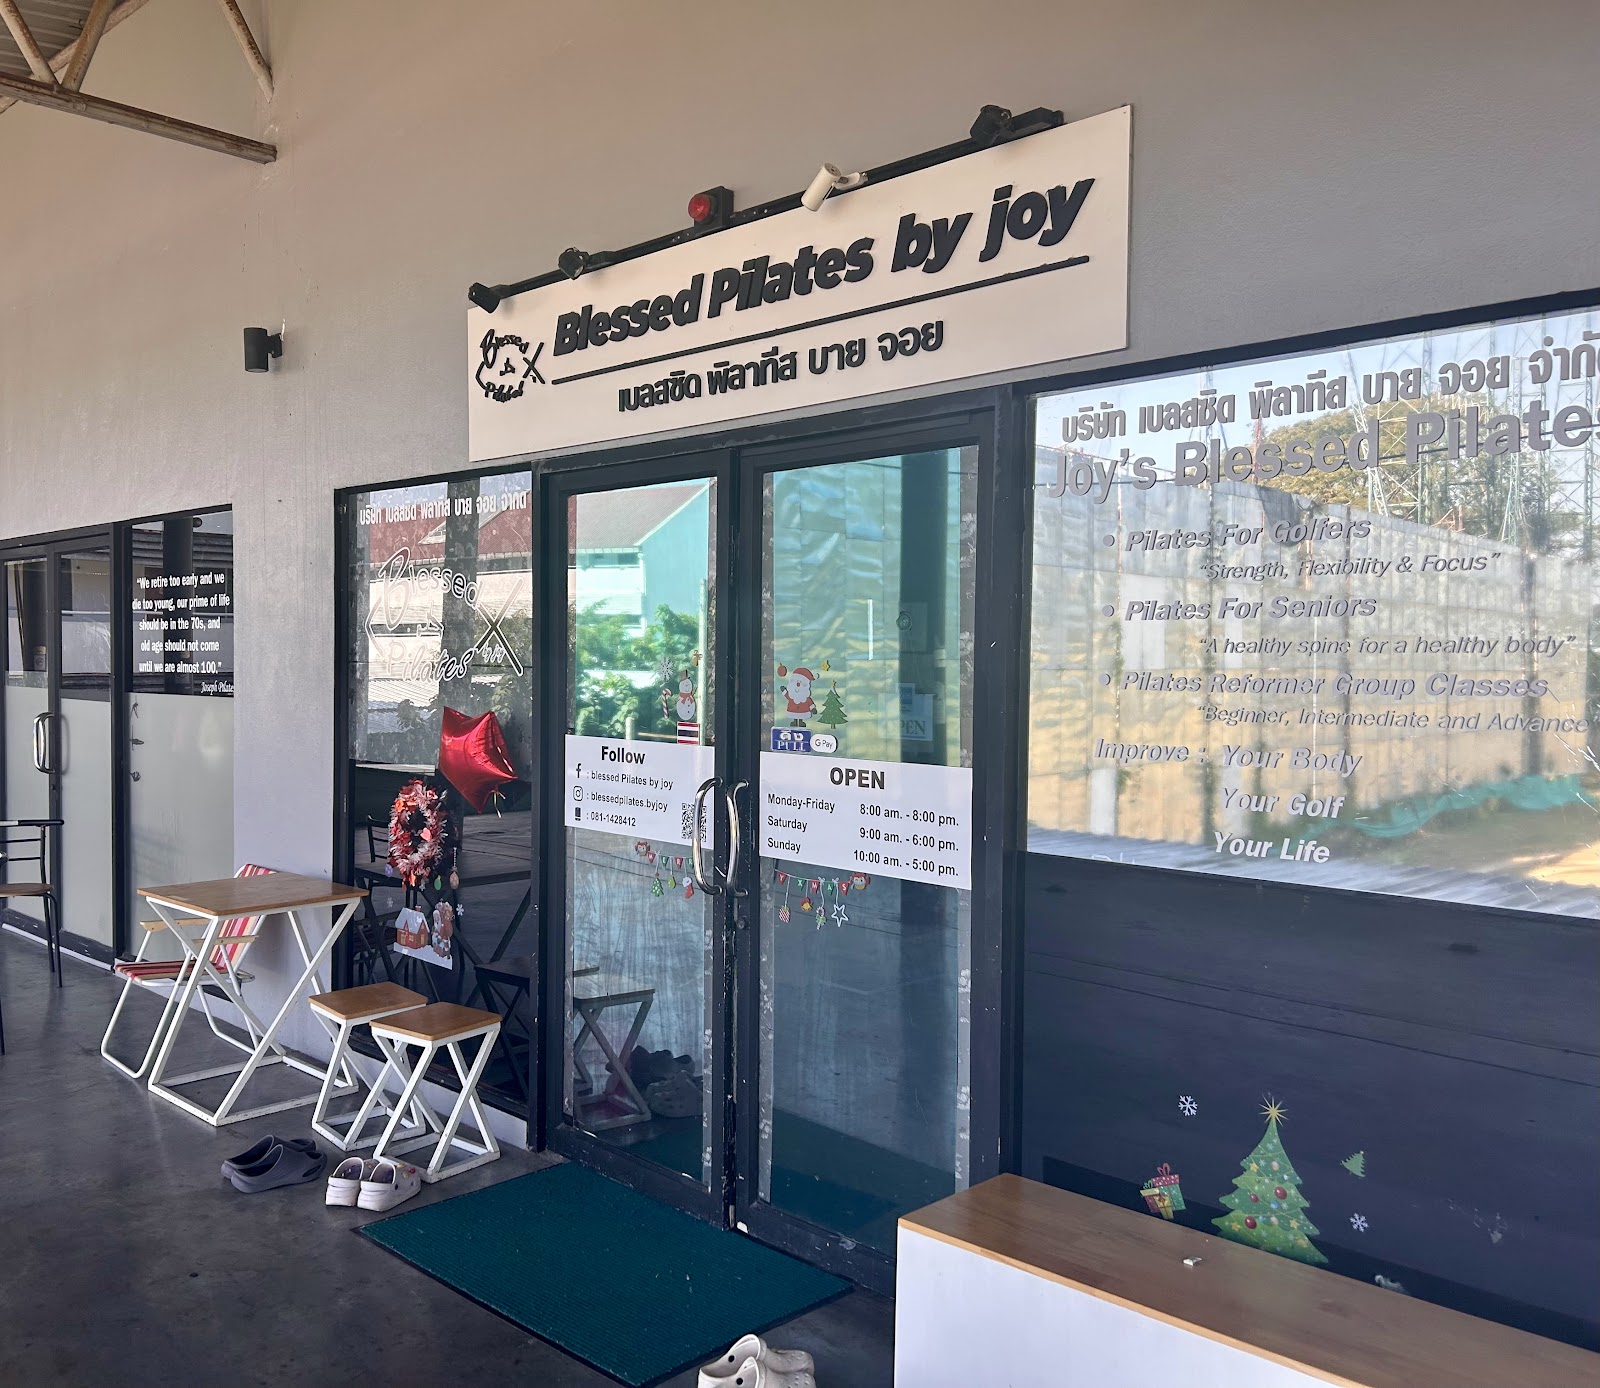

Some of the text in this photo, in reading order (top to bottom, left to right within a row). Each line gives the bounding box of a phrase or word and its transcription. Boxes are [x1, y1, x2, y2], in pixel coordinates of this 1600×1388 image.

[553, 177, 1095, 356] Blessed Pilates by joy
[808, 338, 866, 375] บาย
[877, 320, 944, 361] จอย
[1062, 401, 1126, 443] บริษัท
[1362, 367, 1422, 405] บาย
[1438, 355, 1511, 396] จอย
[1174, 419, 1380, 486] Blessed
[1406, 400, 1600, 465] Pilate
[1125, 517, 1372, 551] Pilates For Golfers
[150, 575, 168, 589] retire
[169, 575, 180, 587] too
[181, 573, 198, 588] early
[199, 572, 213, 585] and
[214, 573, 225, 584] we
[1298, 557, 1392, 578] Flexibility
[1395, 555, 1414, 573] &
[142, 598, 153, 610] too
[154, 597, 176, 612] young,
[176, 598, 188, 609] our
[189, 595, 209, 611] prime
[210, 594, 218, 607] of
[218, 593, 230, 607] life
[378, 546, 484, 631] Blessed
[1124, 594, 1377, 621] Pilates For Seniors
[139, 618, 160, 631] should
[160, 618, 169, 630] be
[169, 618, 177, 630] in
[177, 617, 189, 630] the
[207, 616, 221, 629] and
[140, 639, 220, 654] old age should not come
[1223, 637, 1293, 657] healthy
[1297, 637, 1351, 657] spine
[1359, 636, 1390, 654] for
[1394, 639, 1408, 654] a
[1416, 636, 1500, 658] healthy
[138, 660, 153, 673] until
[153, 662, 164, 673] we
[164, 662, 176, 673] are
[176, 661, 200, 673] almost
[386, 640, 475, 682] Pilates
[1120, 671, 1549, 700] Pilates Reformer Group Classes
[1299, 708, 1429, 728] Intermediate
[1438, 713, 1481, 730] and
[601, 745, 646, 765] Follow
[1094, 738, 1190, 764] Improve
[1222, 744, 1284, 770] Your
[1288, 747, 1363, 778] Body
[591, 770, 620, 783] blessed
[621, 774, 647, 786] Pilates
[649, 777, 659, 789] by
[660, 779, 674, 791] joy
[829, 767, 886, 790] OPEN
[591, 791, 668, 813] blessedpilates.byjoy
[767, 793, 835, 814] Monday-Friday
[859, 803, 881, 818] 8:00
[883, 808, 903, 820] am.
[912, 809, 935, 824] 8:00
[938, 813, 960, 828] pm.
[1221, 787, 1345, 819] Your Golf
[590, 811, 637, 827] 081-1428412
[767, 815, 808, 833] Saturday
[859, 827, 881, 841] 9:00
[883, 832, 903, 844] am.
[912, 834, 935, 849] 6:00
[938, 837, 960, 852] pm.
[1214, 831, 1331, 864] Your Life
[767, 837, 802, 855] Sunday
[853, 849, 880, 864] 10:00
[883, 856, 903, 868] am.
[912, 858, 935, 873] 5:00
[938, 862, 960, 877] pm.
